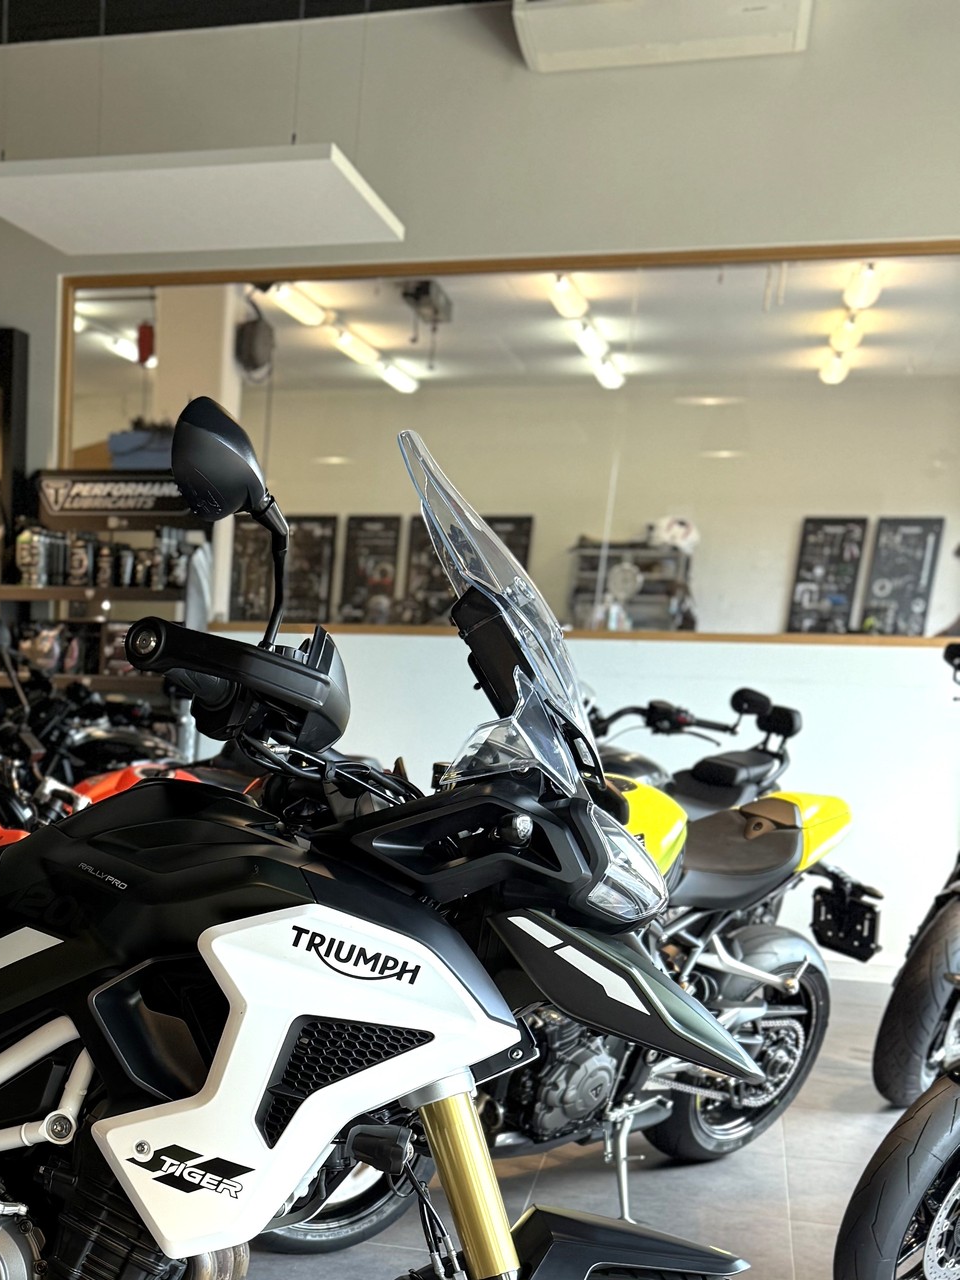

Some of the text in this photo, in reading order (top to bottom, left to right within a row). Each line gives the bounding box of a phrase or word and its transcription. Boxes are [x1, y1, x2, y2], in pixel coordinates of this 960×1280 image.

[63, 496, 156, 509] LUBRICANTS
[70, 482, 182, 497] PERFORMAN
[291, 924, 422, 985] TRIUMPH
[159, 1155, 244, 1200] TIGER
